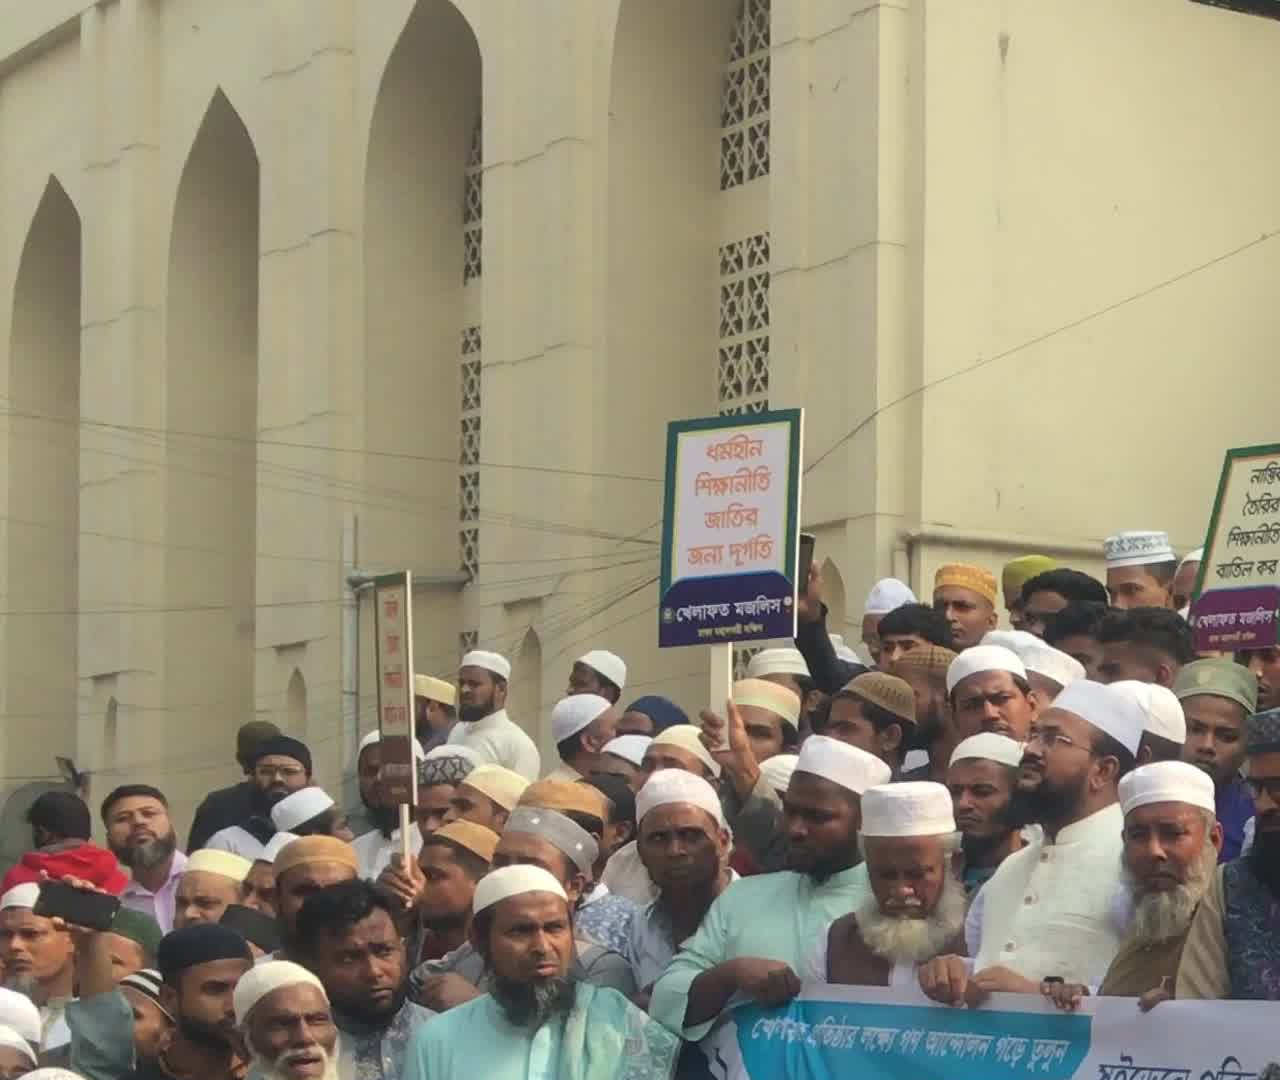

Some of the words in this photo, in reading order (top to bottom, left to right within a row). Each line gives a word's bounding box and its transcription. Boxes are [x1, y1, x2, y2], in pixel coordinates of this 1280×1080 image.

[695, 465, 771, 496] শিক্ষানীতি
[704, 502, 758, 529] জাতির
[1242, 490, 1280, 516] তৈরির
[1227, 522, 1280, 548] শিক্ষানীতি
[688, 544, 724, 565] জন্য
[1216, 556, 1254, 578] বাতিল
[1257, 560, 1279, 577] কর
[676, 603, 730, 622] খেলাফত
[734, 595, 781, 617] মজলিস
[996, 1035, 1029, 1068] গড়ে
[1027, 1039, 1071, 1073] তুলুন
